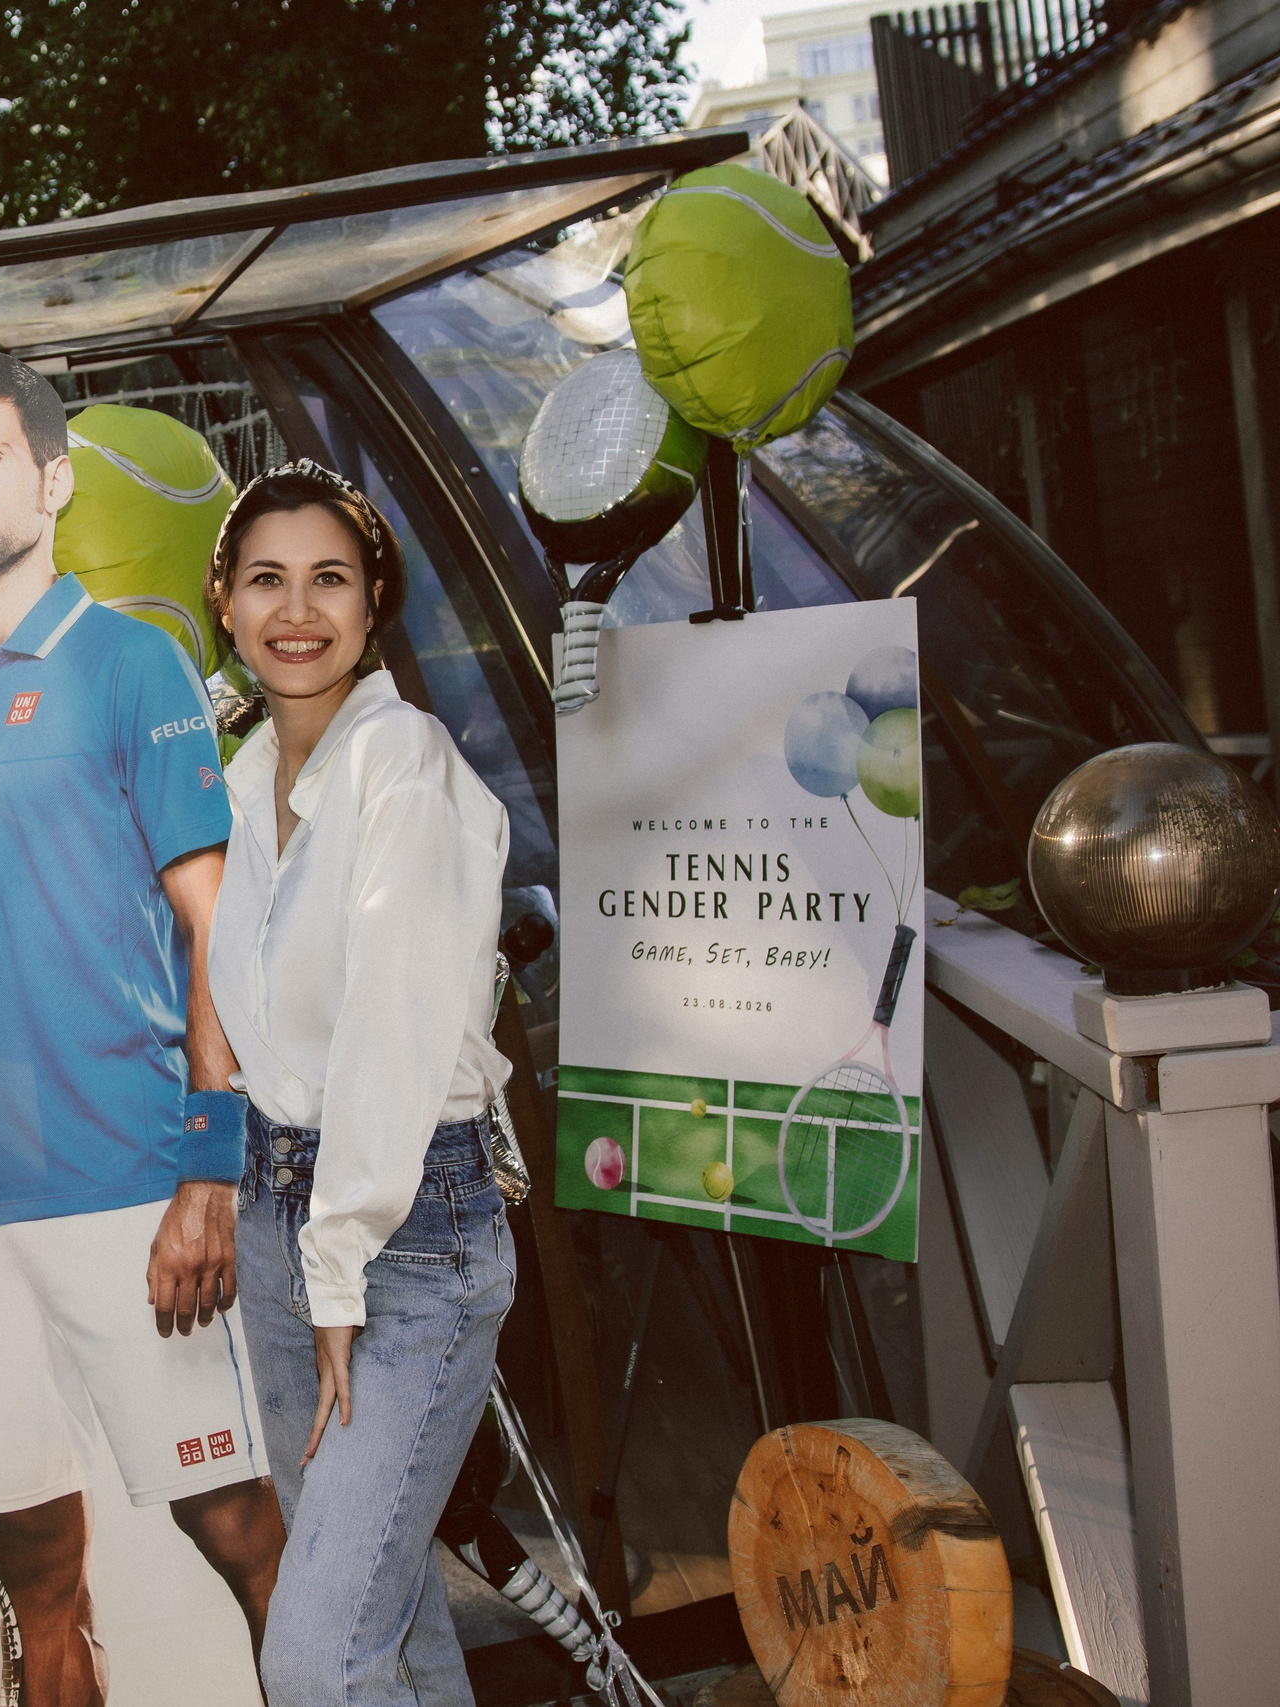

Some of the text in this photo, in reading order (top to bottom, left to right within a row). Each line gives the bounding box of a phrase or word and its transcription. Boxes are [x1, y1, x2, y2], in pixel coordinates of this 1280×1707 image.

[15, 696, 36, 708] UNI
[10, 708, 32, 722] QLO
[632, 817, 828, 831] WELCOME TO THE
[666, 853, 790, 882] TENNIS
[598, 889, 870, 922] GENDER PARTY
[631, 941, 831, 970] GAME, SET, BABY!
[683, 997, 772, 1012] 23.08.2026
[210, 1433, 229, 1446] UNI
[212, 1443, 233, 1457] QLO
[776, 1526, 898, 1632] МАЙ
